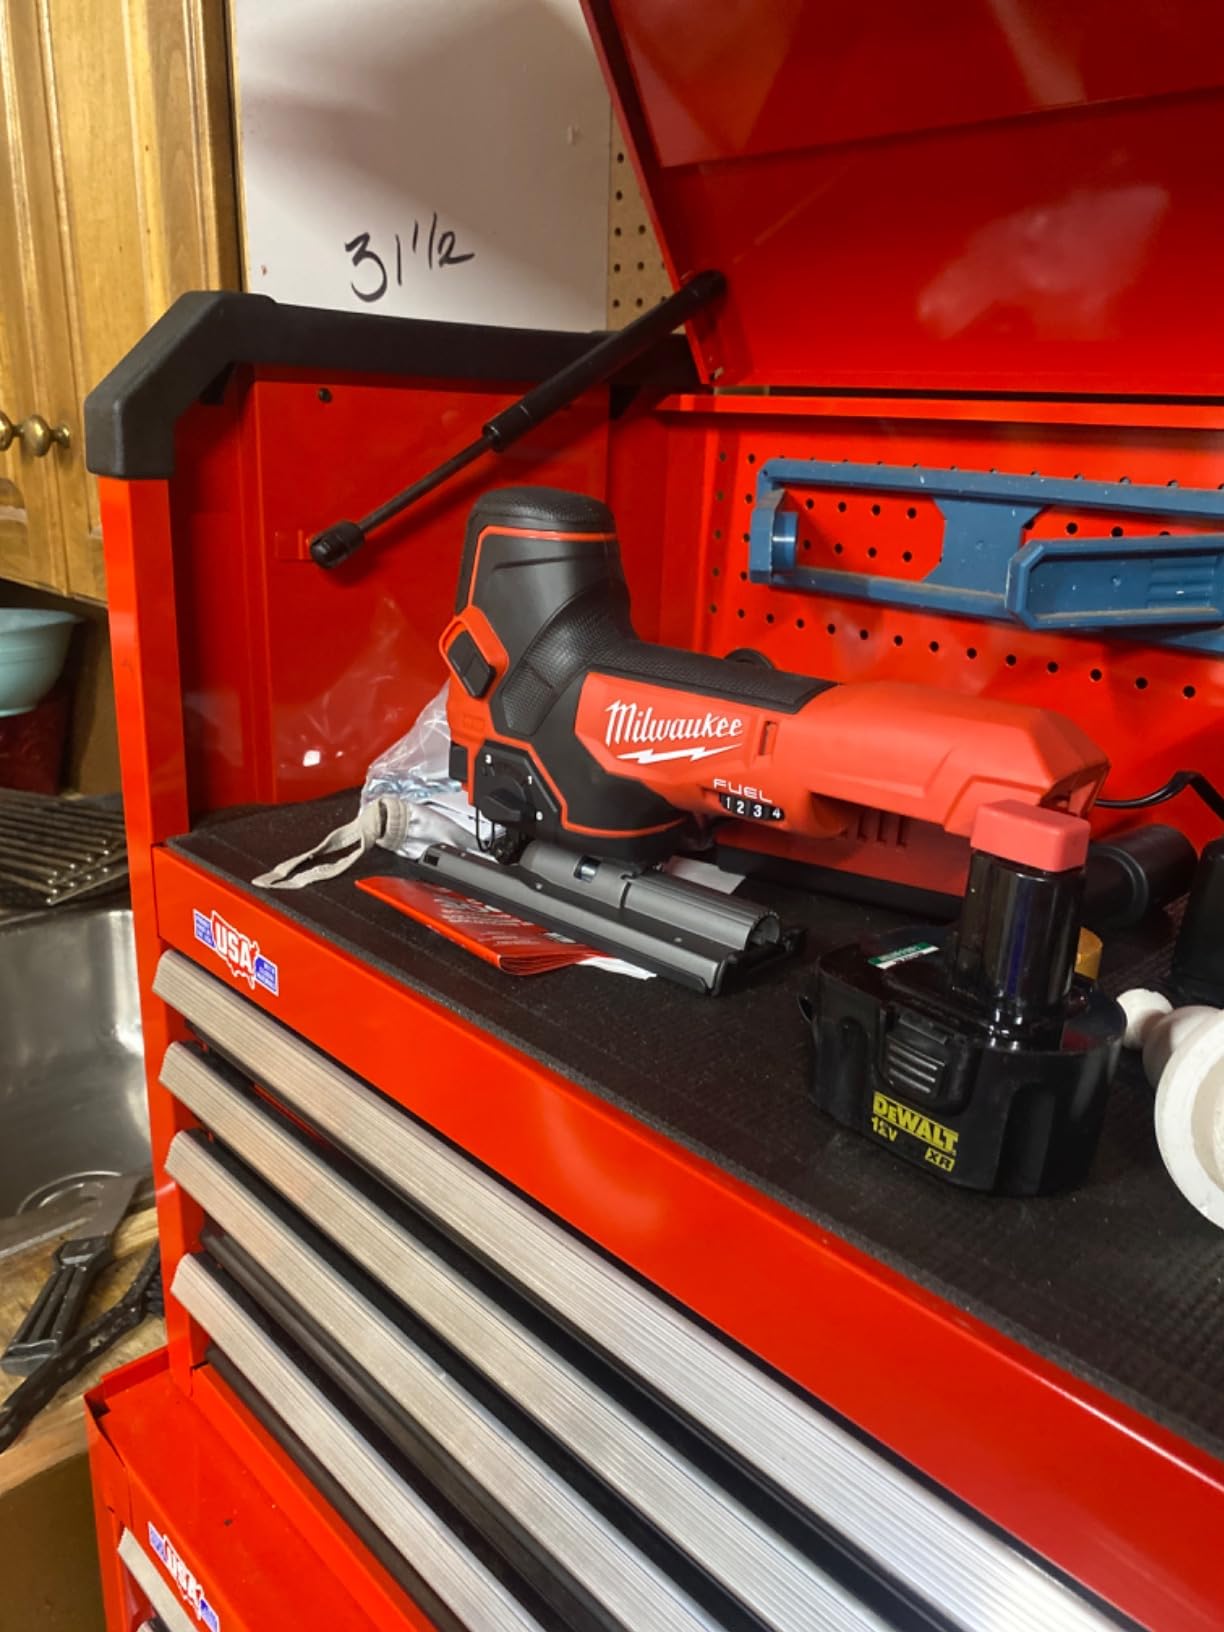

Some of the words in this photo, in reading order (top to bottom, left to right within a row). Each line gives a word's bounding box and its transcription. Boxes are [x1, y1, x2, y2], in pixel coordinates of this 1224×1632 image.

[605, 700, 744, 746] Milwaukee
[713, 778, 773, 804] FUEL
[726, 796, 731, 809] 1
[736, 800, 745, 814] 2
[753, 804, 763, 818] 3
[772, 807, 781, 819] 4
[215, 921, 254, 975] USA
[926, 1148, 955, 1171] XR
